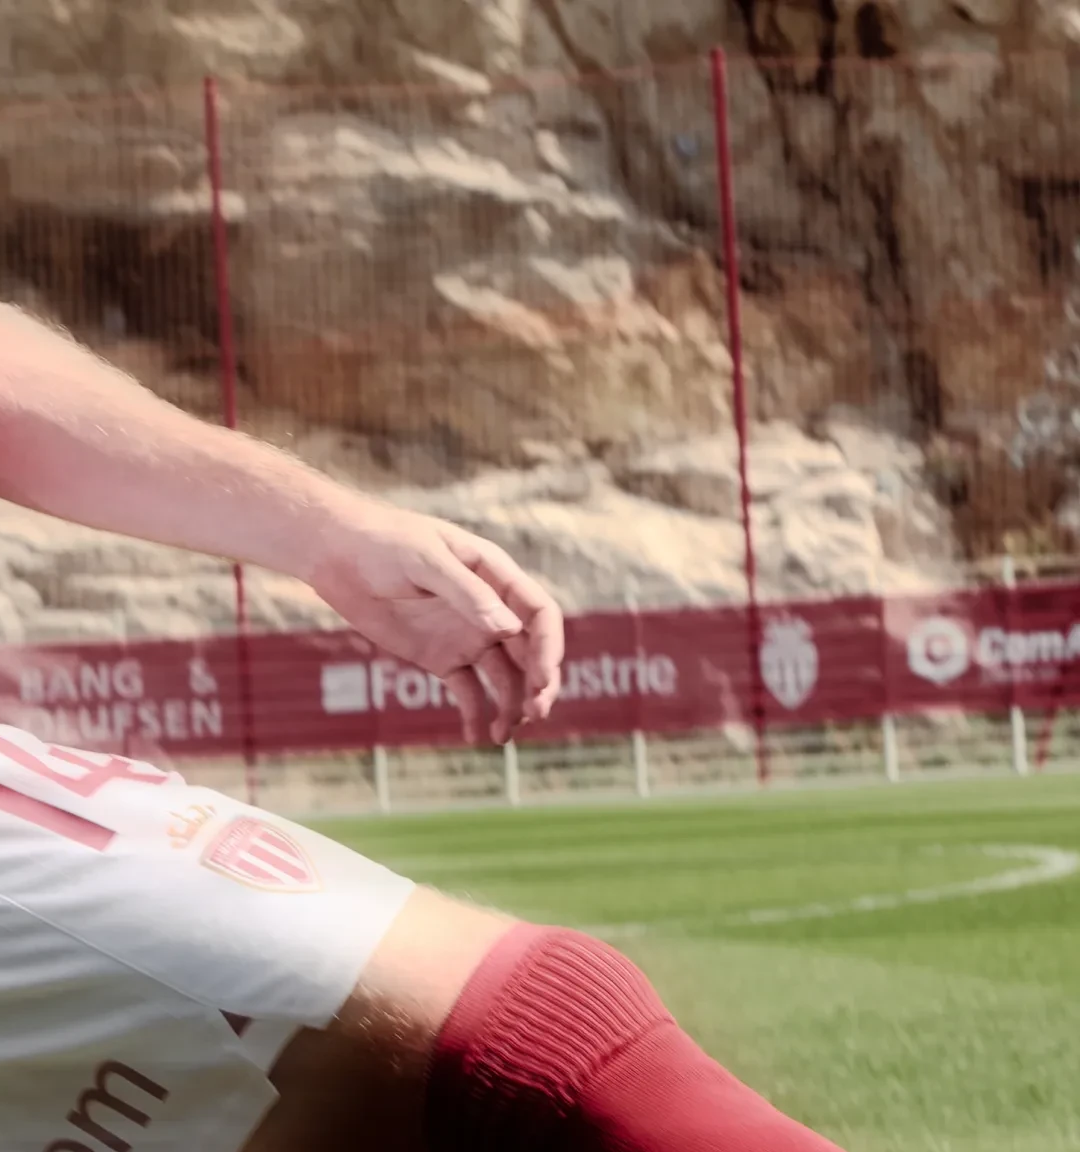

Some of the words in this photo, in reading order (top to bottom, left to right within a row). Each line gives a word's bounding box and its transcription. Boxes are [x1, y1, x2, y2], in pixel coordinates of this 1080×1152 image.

[20, 659, 145, 703] BANG
[187, 656, 219, 696] &
[22, 699, 224, 742] OLUFSEN
